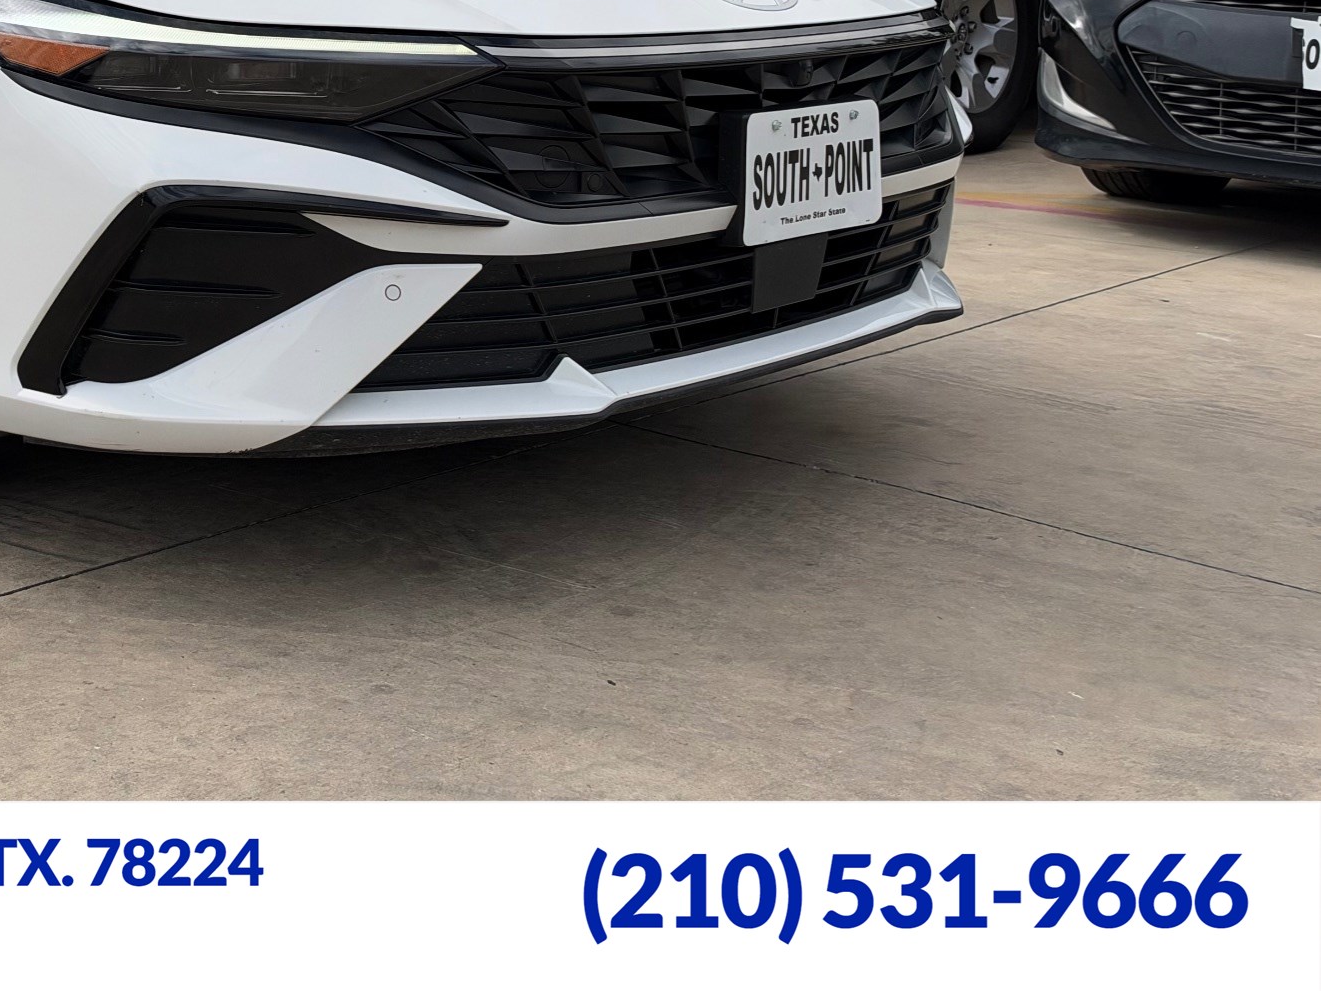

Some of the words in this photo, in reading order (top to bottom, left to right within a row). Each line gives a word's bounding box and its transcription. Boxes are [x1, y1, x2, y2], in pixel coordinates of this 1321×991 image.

[790, 111, 839, 139] TEXAS
[752, 147, 811, 210] SOUTH
[824, 138, 874, 197] POINT
[780, 216, 794, 225] The
[795, 213, 811, 223] Lone
[812, 210, 827, 219] Star
[828, 207, 846, 217] State
